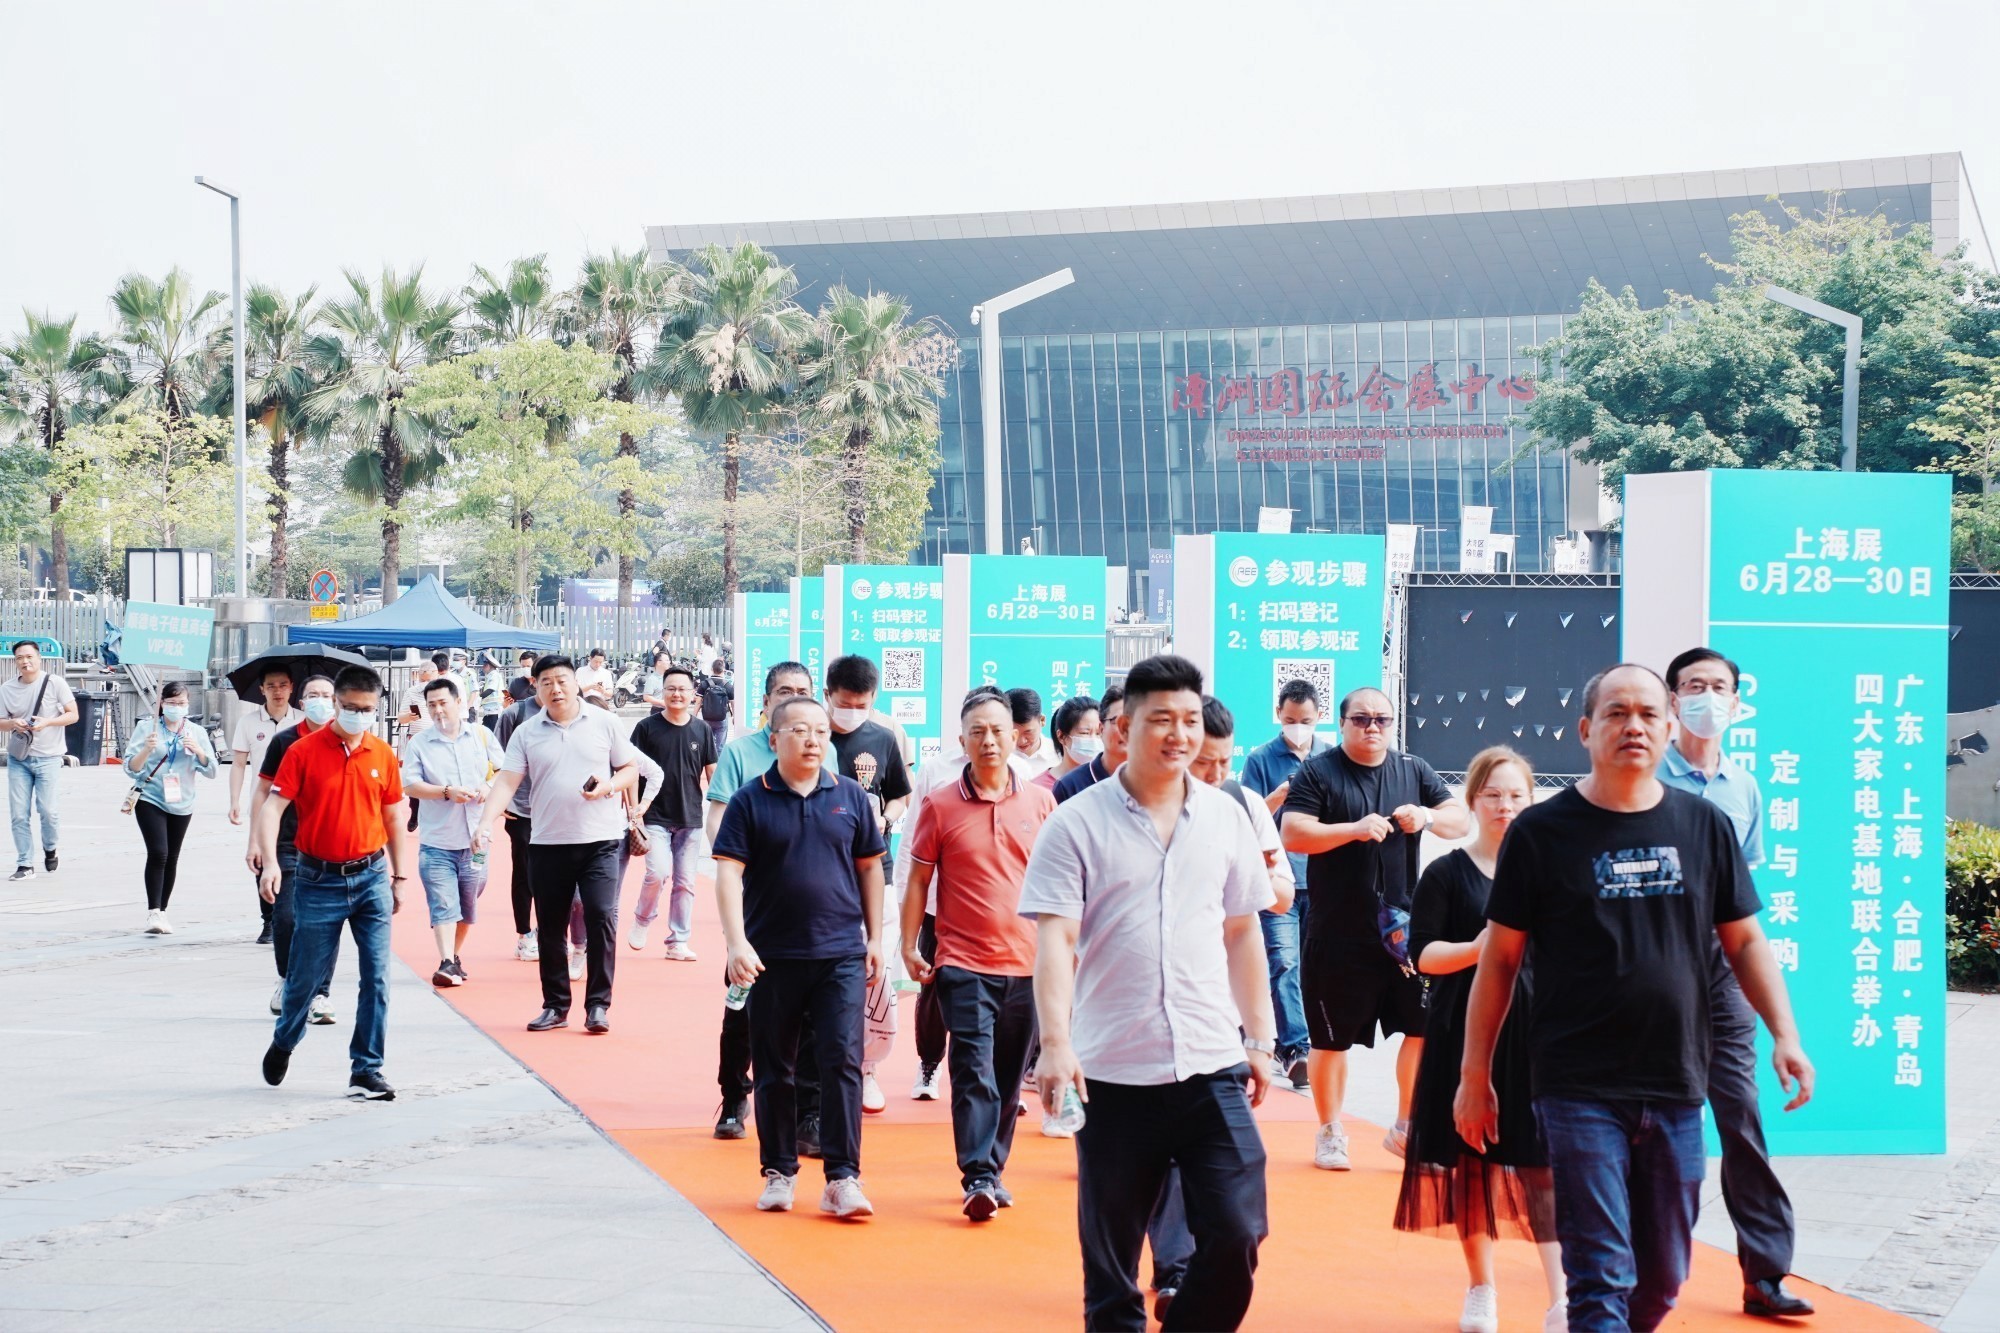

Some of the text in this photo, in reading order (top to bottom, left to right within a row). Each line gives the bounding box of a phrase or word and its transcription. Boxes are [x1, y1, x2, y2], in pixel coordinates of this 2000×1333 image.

[1402, 424, 1504, 440] CONVENTION
[1785, 527, 1882, 562] 上海展
[1265, 559, 1368, 588] 参观步骤
[1012, 584, 1066, 602] 上海展
[1075, 661, 1091, 697] 广东
[1768, 750, 1800, 973] 定制与采购
[1852, 674, 1884, 1047] 四大家电基地联合举办
